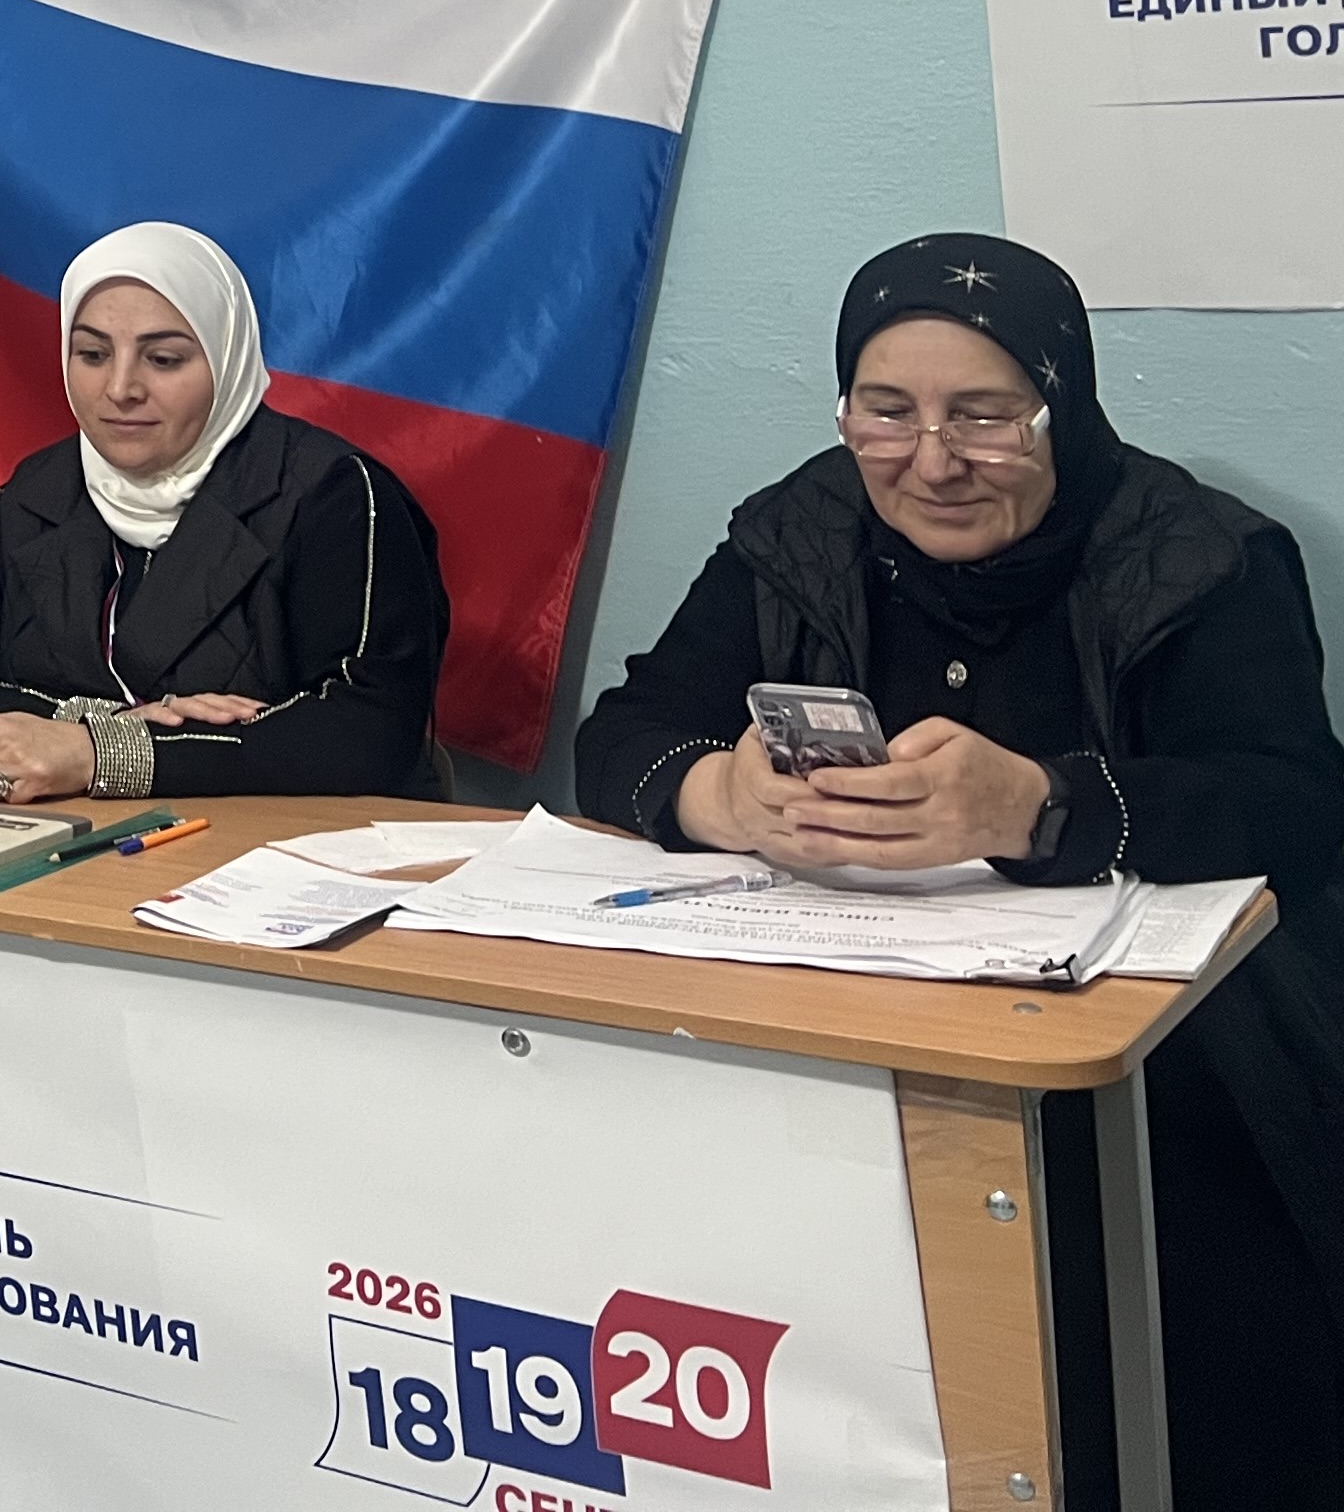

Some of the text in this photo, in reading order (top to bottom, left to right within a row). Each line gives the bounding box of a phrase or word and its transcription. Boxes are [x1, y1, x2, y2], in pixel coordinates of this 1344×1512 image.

[327, 1262, 442, 1319] 2026
[348, 1330, 751, 1462] 18 19 20
